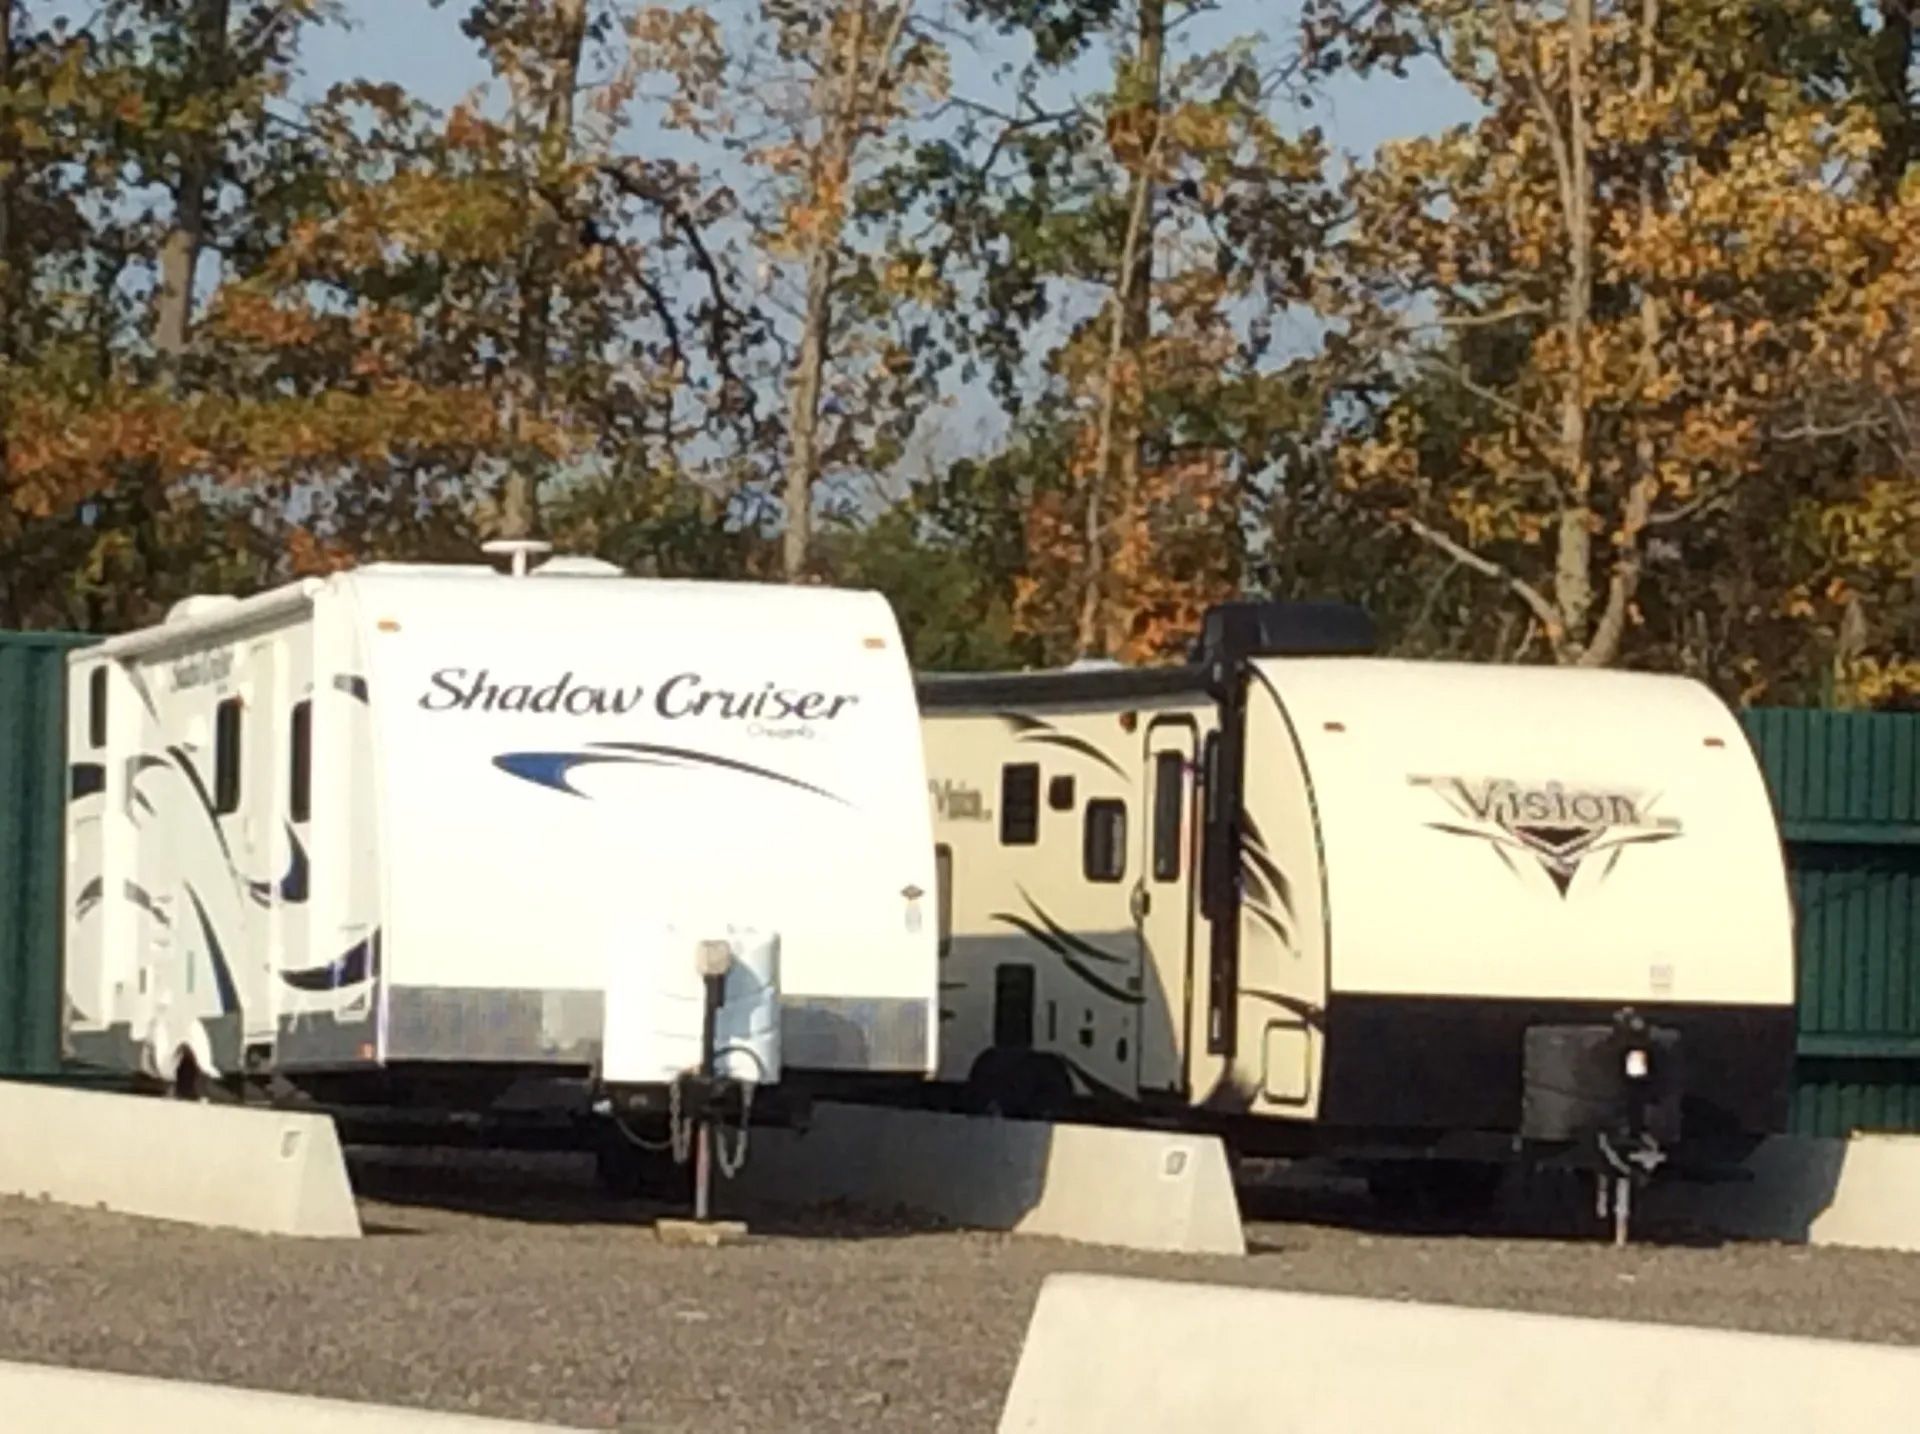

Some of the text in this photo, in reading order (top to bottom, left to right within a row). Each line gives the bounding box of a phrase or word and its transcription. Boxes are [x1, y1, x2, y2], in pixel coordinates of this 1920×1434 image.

[417, 667, 861, 721] Shadow Cruiser
[1450, 776, 1640, 825] Vision
